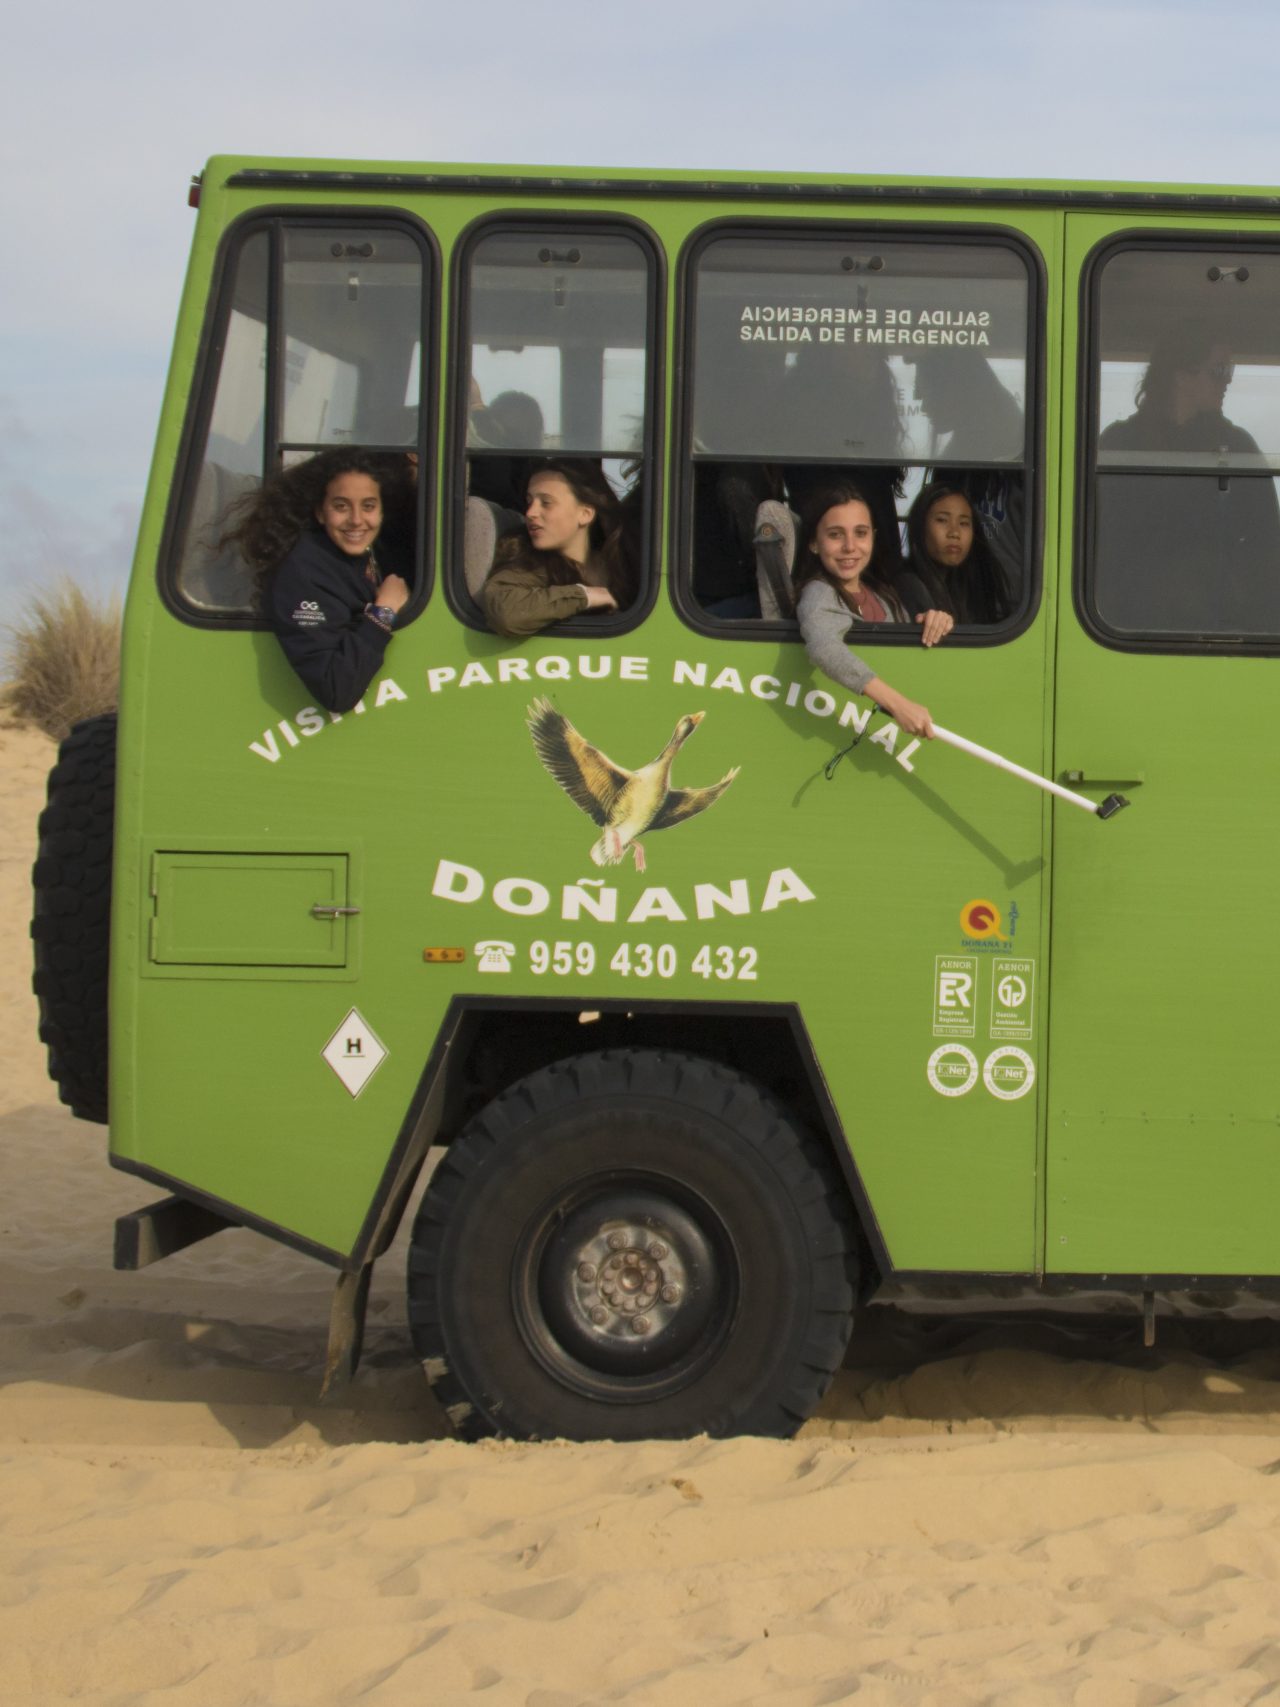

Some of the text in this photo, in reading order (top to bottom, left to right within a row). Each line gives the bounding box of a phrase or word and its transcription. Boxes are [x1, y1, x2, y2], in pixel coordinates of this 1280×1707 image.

[740, 326, 812, 342] SALIDA
[819, 327, 845, 343] DE
[248, 655, 921, 773] VISA PARQUE NACIONAL
[432, 859, 816, 922] DOÑANA
[529, 940, 758, 980] 959 430 432
[940, 960, 972, 969] AENOR
[998, 963, 1030, 972] AENOR
[939, 972, 972, 1007] ER
[346, 1038, 361, 1053] H
